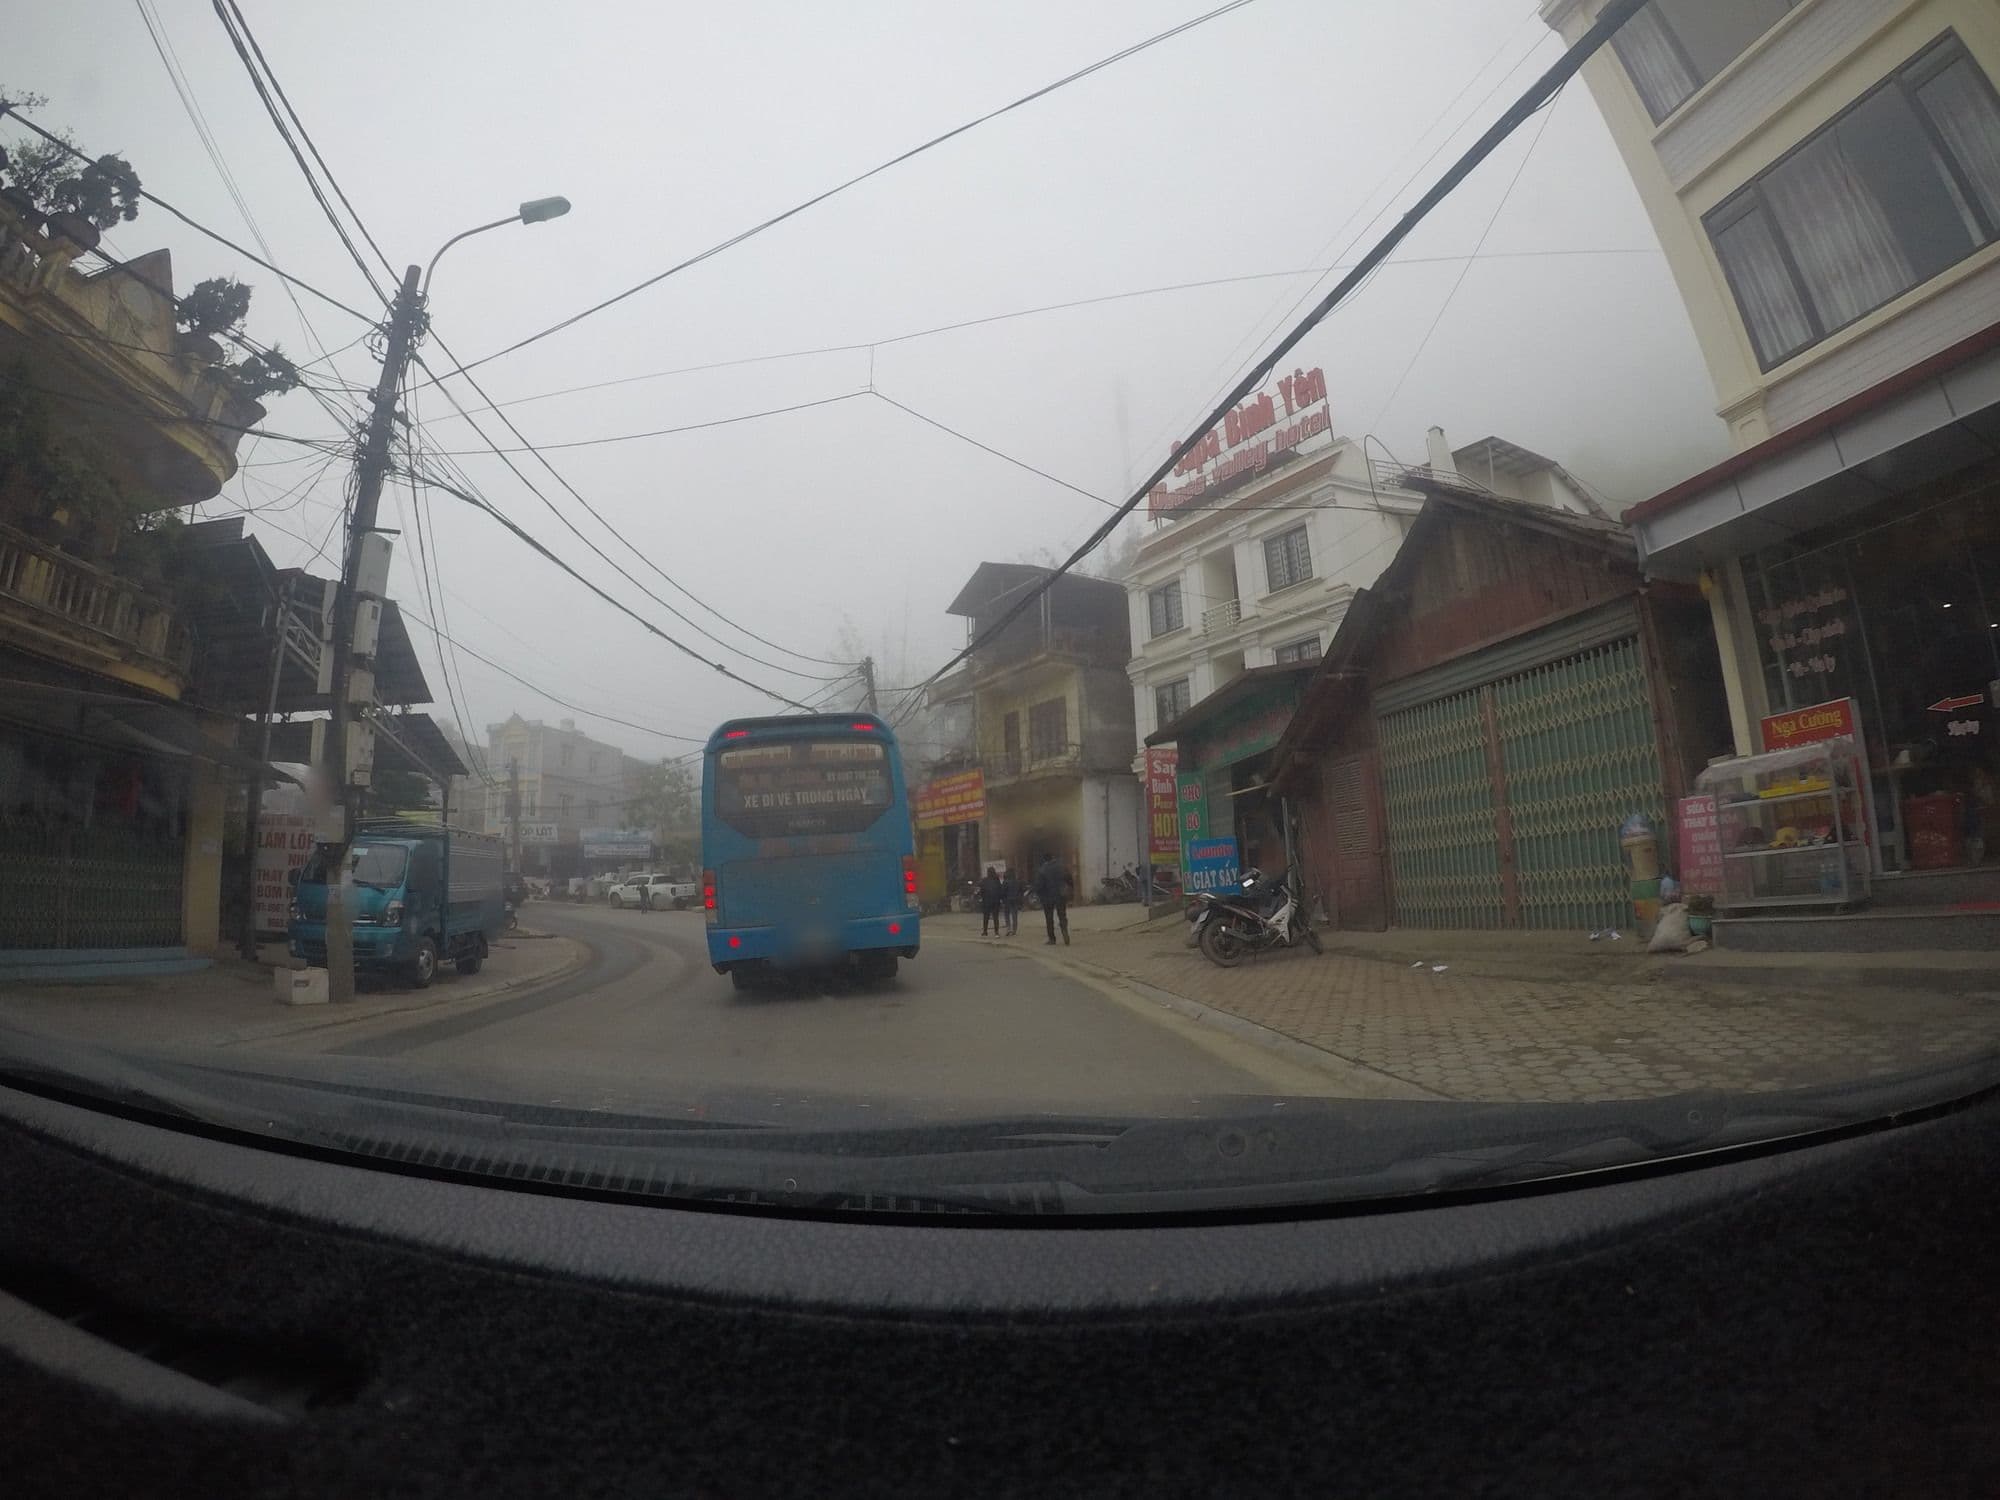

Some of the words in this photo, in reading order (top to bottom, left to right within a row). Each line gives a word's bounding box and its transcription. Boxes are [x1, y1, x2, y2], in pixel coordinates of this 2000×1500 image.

[1277, 368, 1327, 416] Yên
[1275, 404, 1331, 450] hotel
[1153, 813, 1178, 837] HOT
